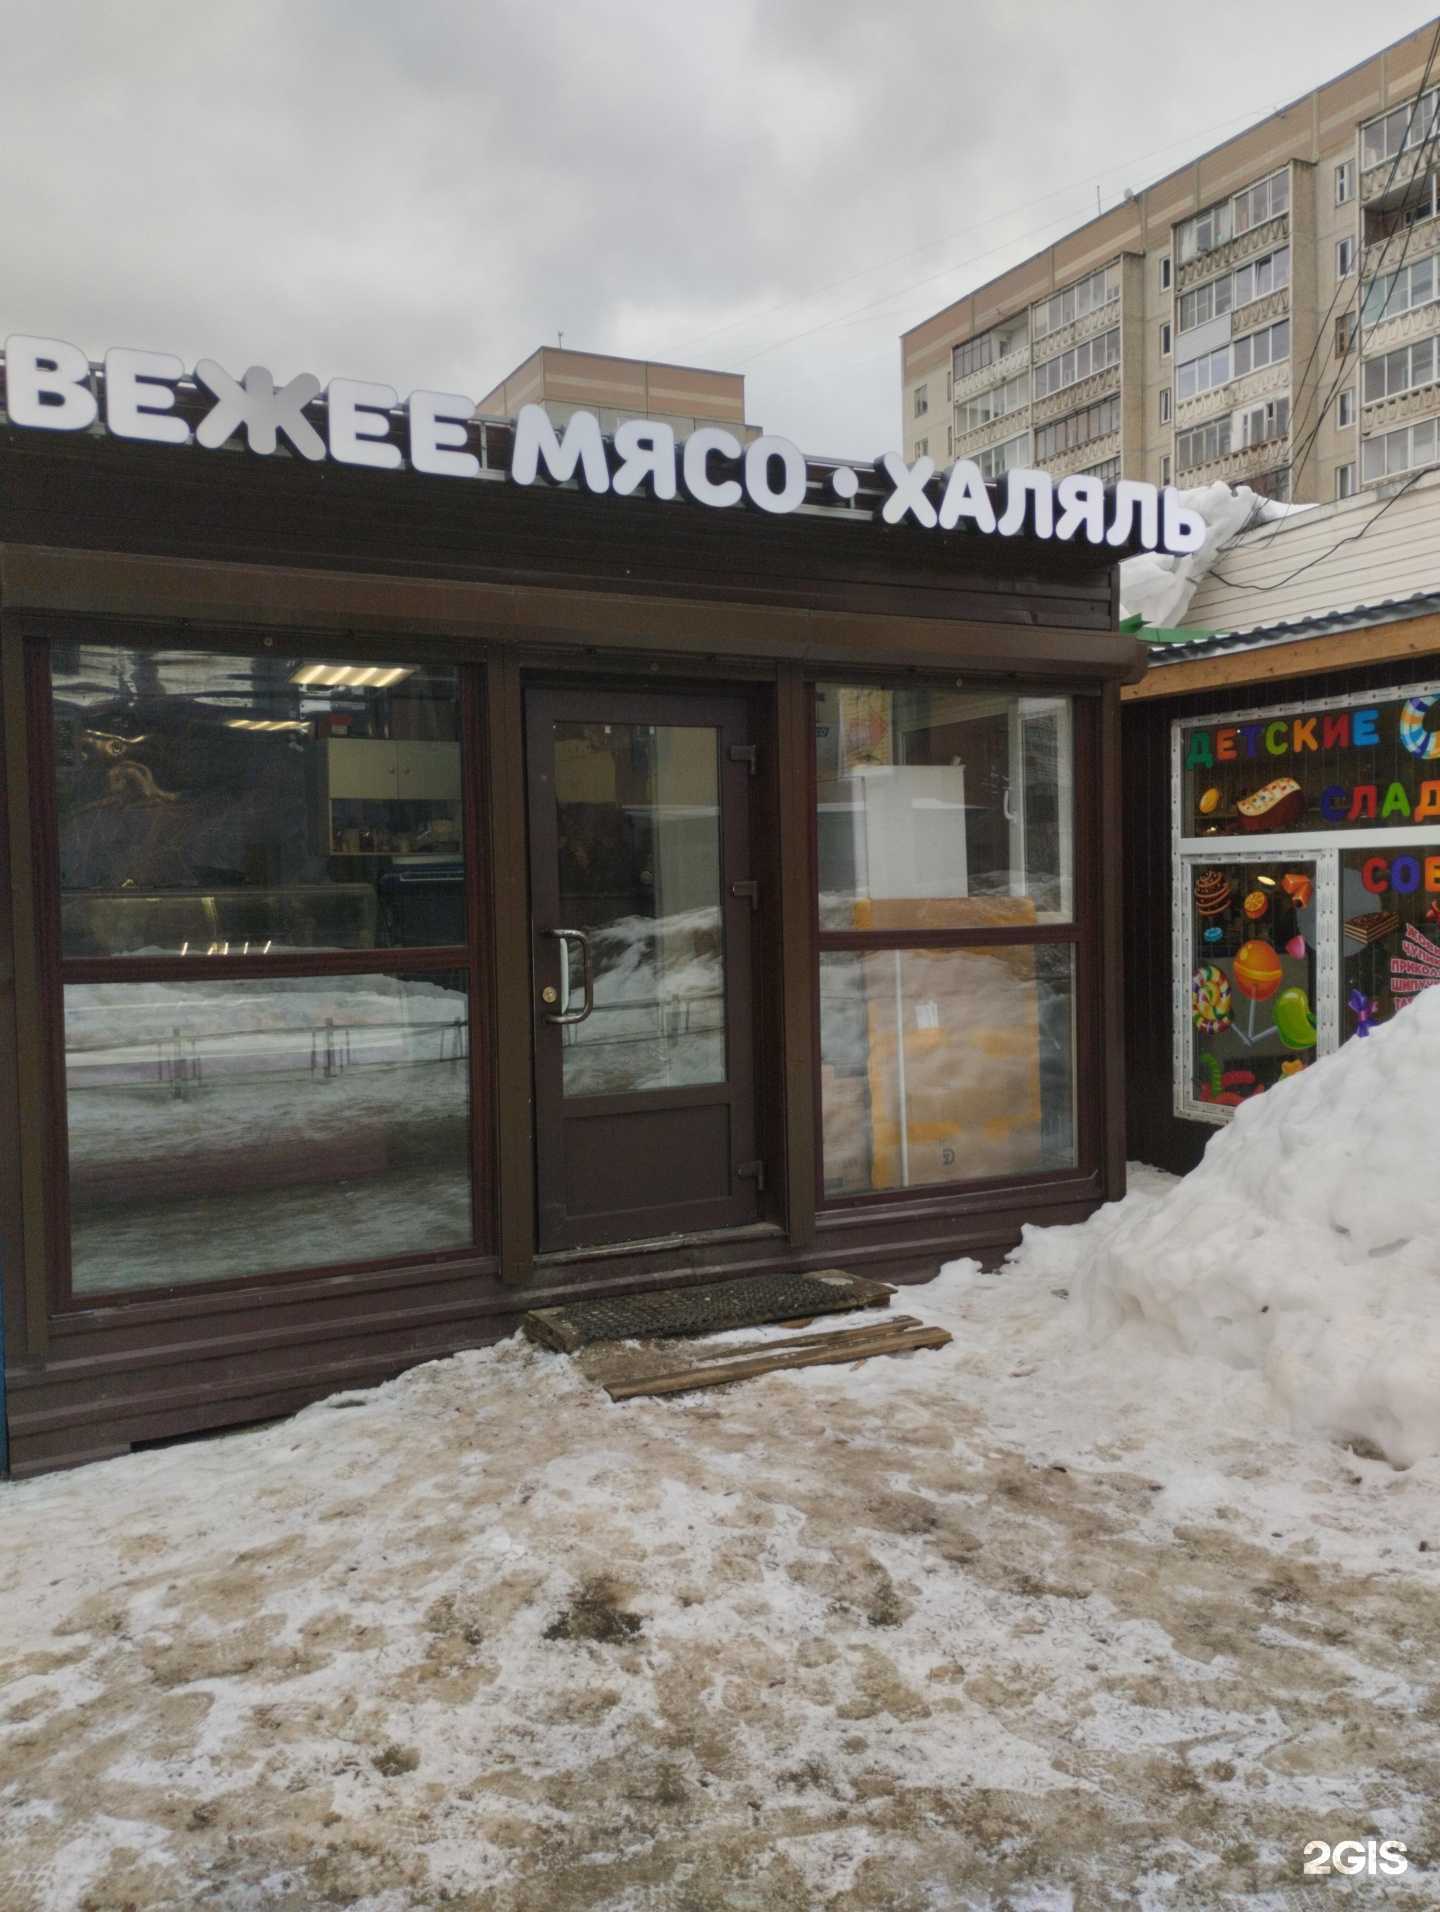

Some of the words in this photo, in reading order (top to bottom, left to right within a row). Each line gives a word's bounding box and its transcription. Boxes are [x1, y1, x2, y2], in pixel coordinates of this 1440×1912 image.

[5, 334, 480, 478] ВЕЖЕЕ
[511, 403, 807, 514] МЯСО
[878, 451, 1206, 553] ХАЛЯЛЬ
[1186, 709, 1379, 770] ДЕТСКИЕ
[1321, 780, 1440, 823] СЛАД
